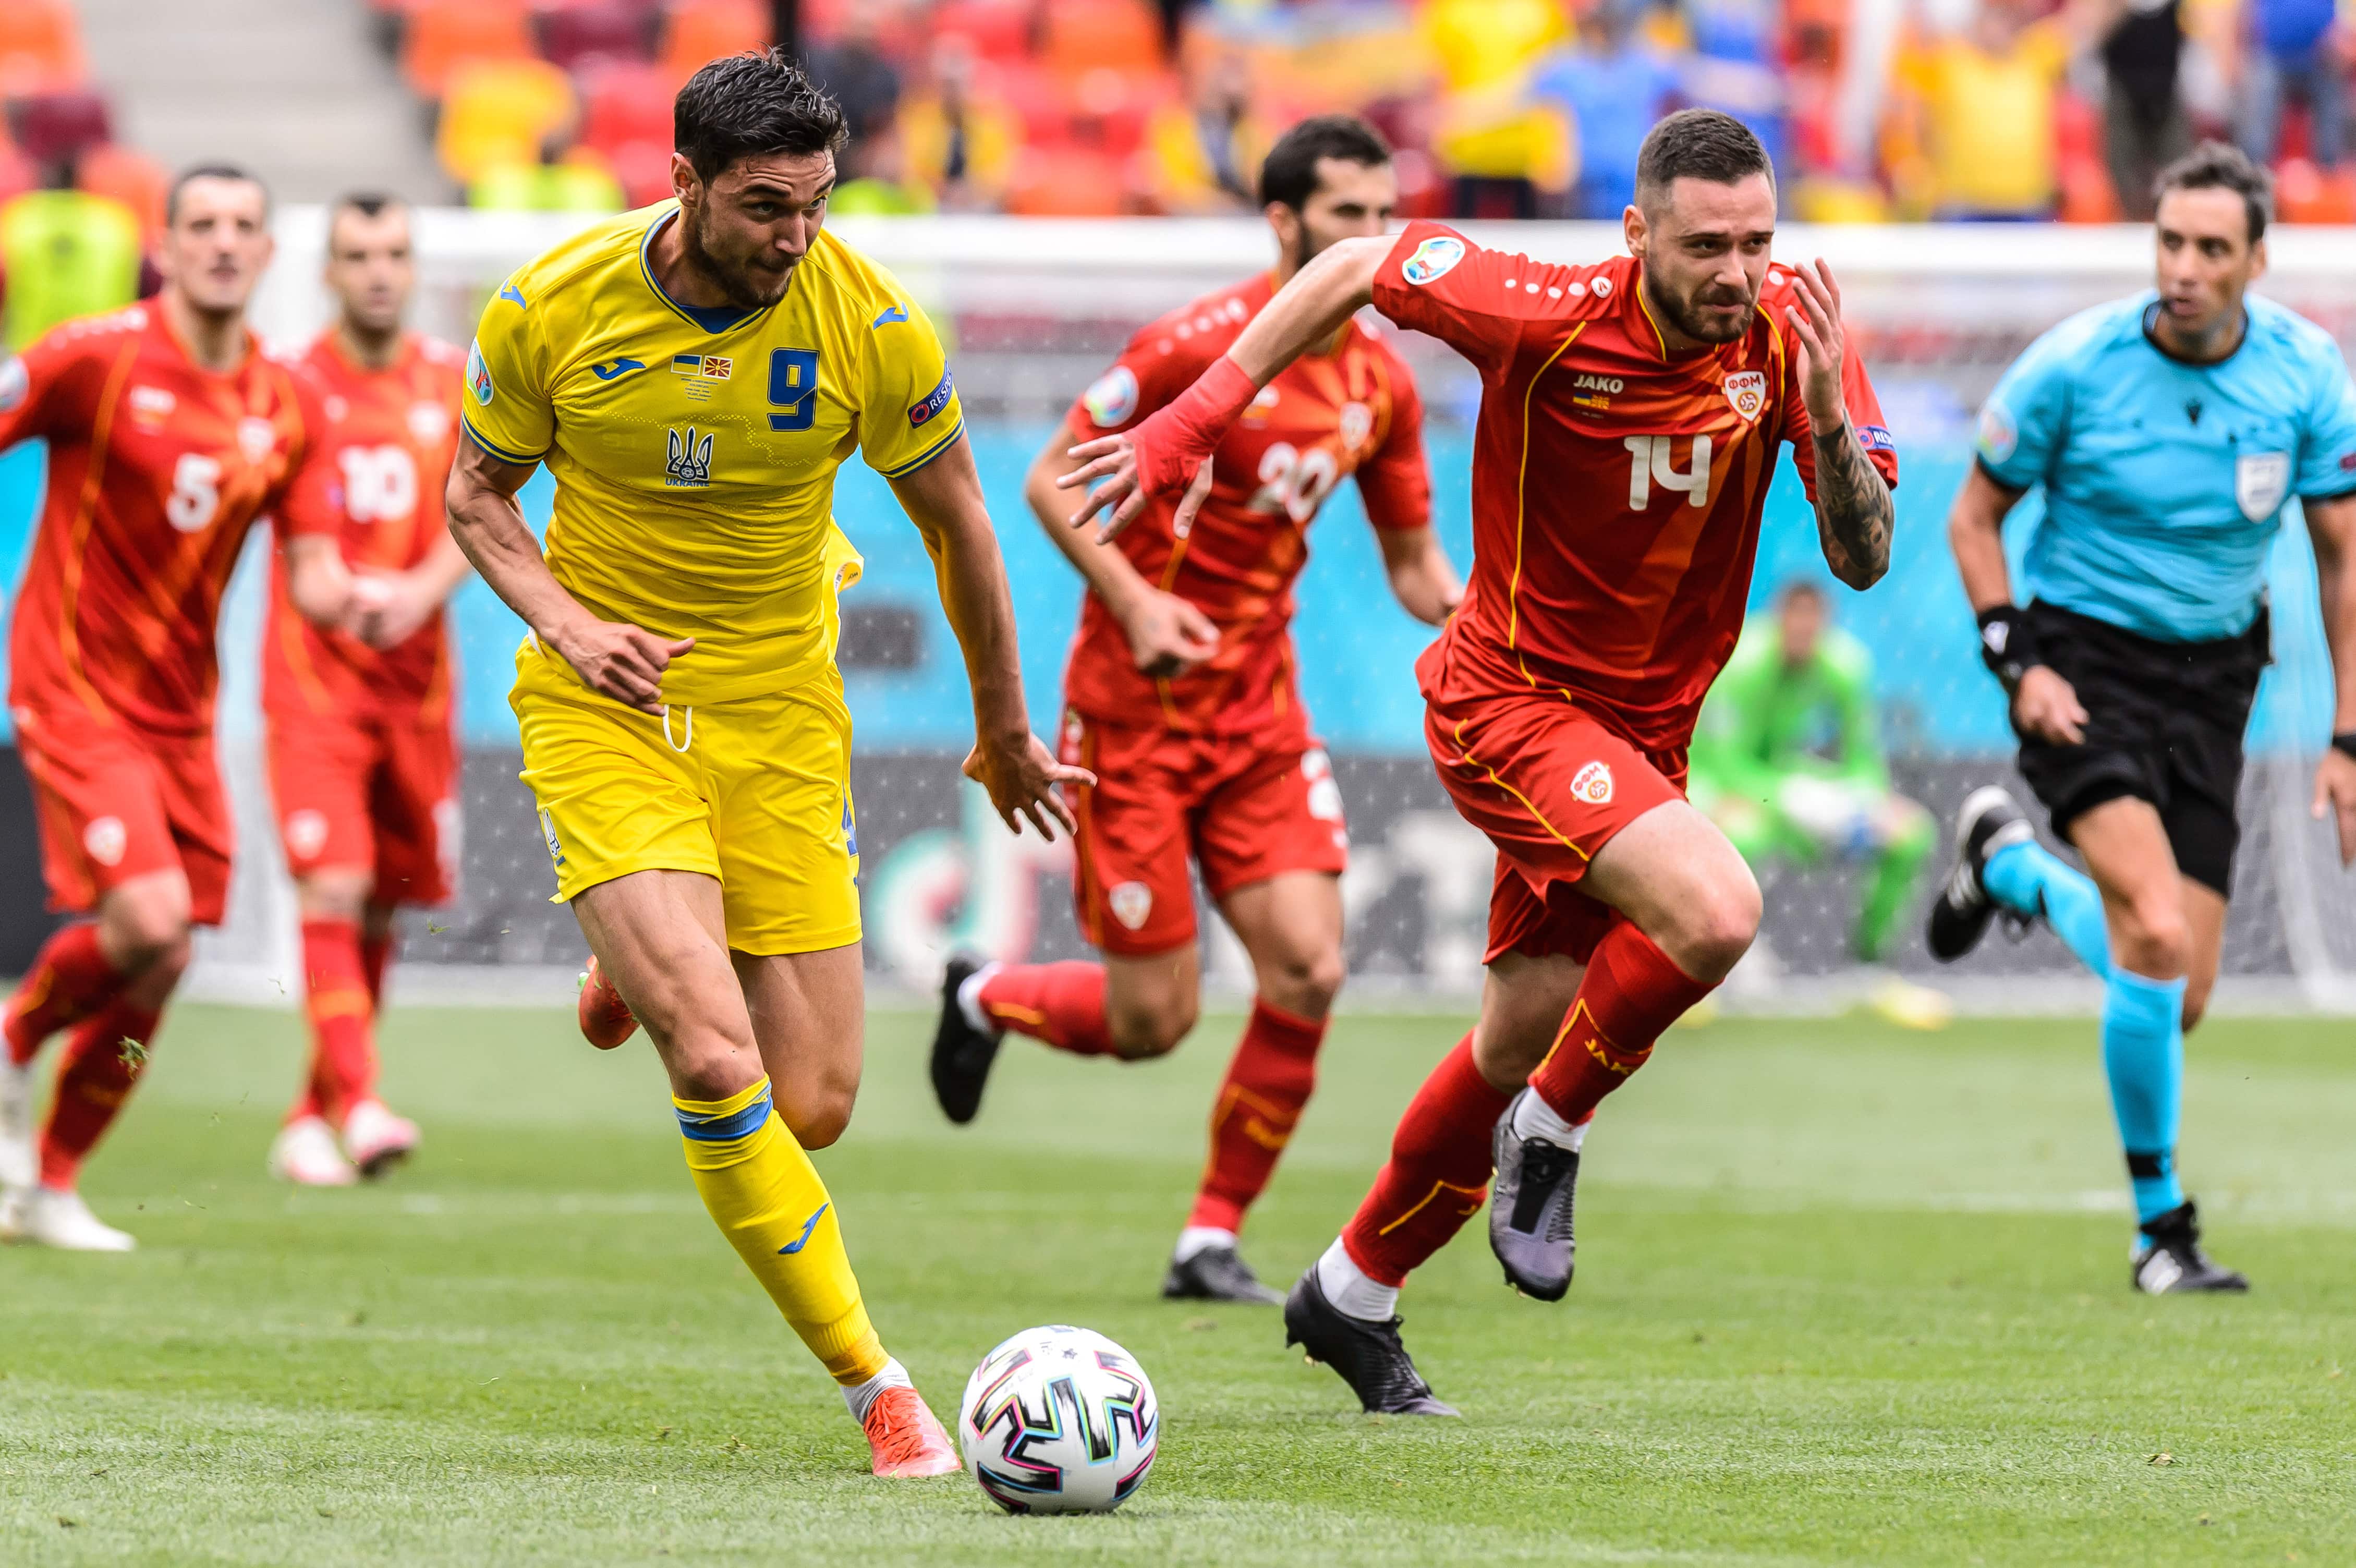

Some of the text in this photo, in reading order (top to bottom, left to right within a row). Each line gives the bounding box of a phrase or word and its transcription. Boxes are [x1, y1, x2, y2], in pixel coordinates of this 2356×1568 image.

[767, 348, 819, 431] 9
[929, 368, 952, 410] RESPE
[1573, 374, 1623, 394] JAKO
[167, 452, 220, 532] 5
[338, 445, 417, 522] 10
[665, 477, 710, 487] UKRAINE
[1248, 442, 1338, 521] 20
[1624, 434, 1713, 511] 14
